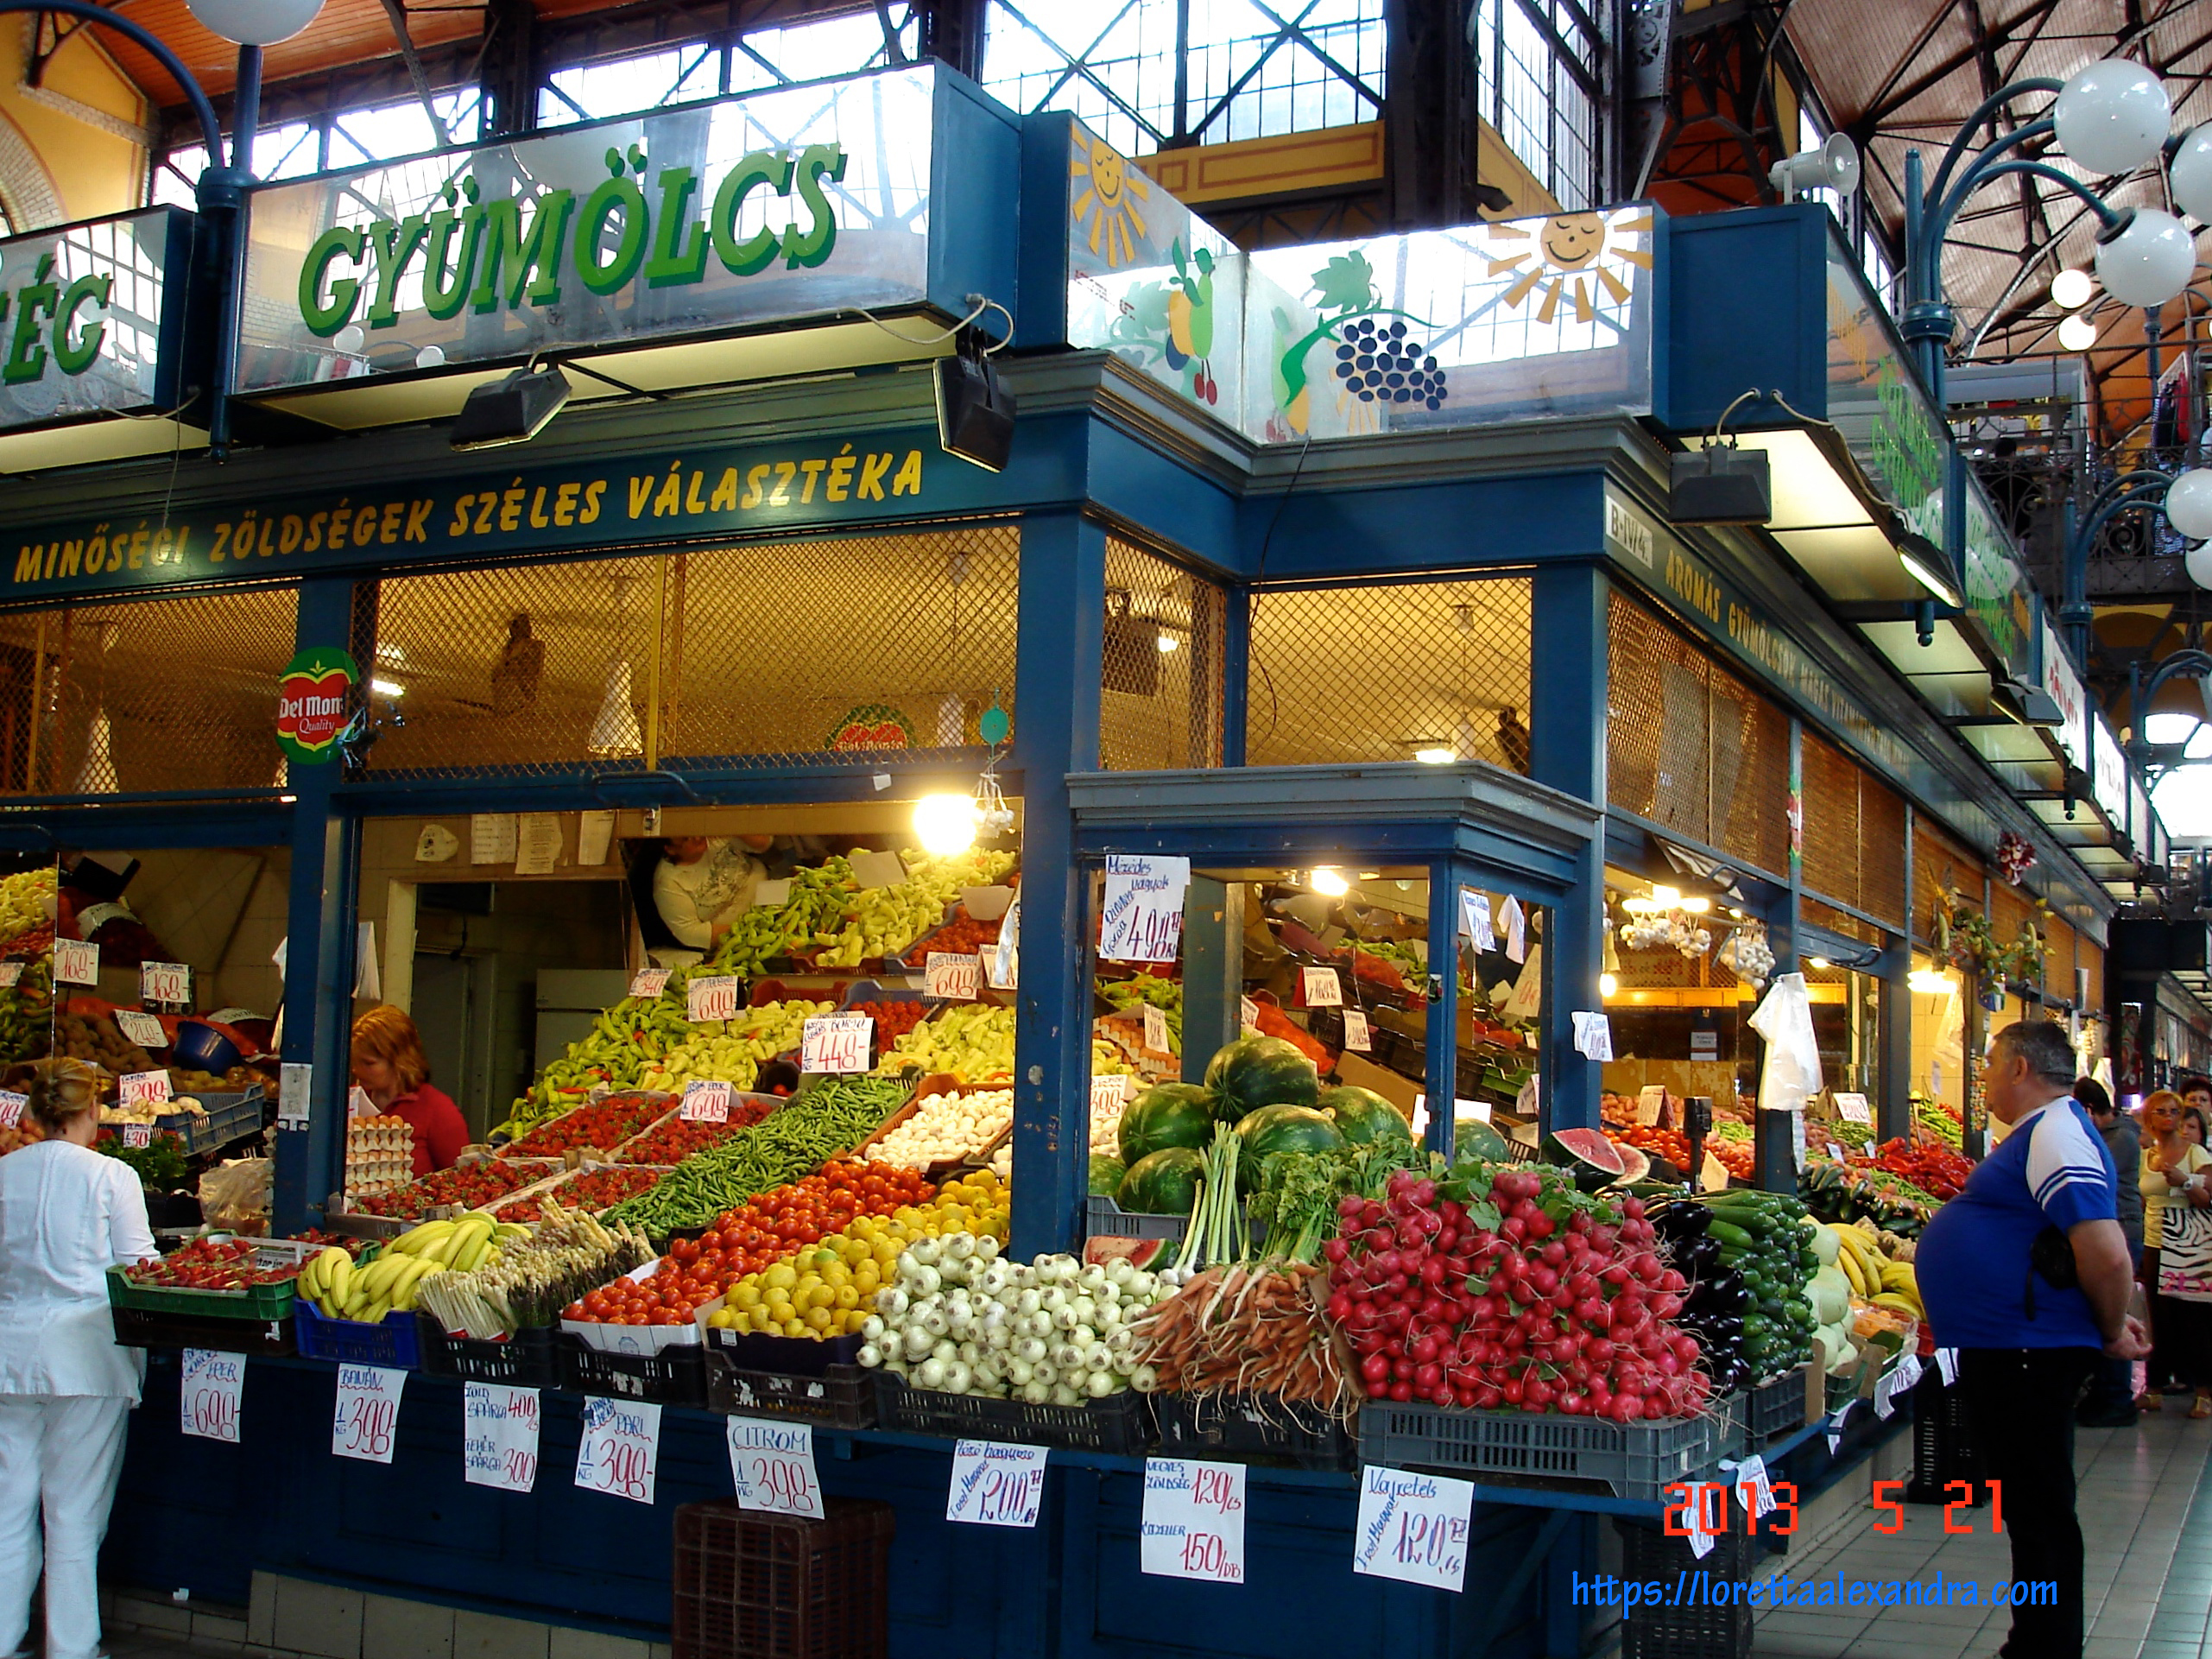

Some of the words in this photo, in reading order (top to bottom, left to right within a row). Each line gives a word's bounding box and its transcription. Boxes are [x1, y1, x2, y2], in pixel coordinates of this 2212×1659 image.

[299, 142, 847, 338] GYÜMÖLCS
[0, 252, 113, 386] ÉG
[14, 522, 192, 585] MINŐSÉGI
[211, 498, 433, 564] ZÖLDSÉGEK
[449, 478, 607, 537] SZÉLES
[628, 443, 923, 520] VÁLASZTÉKA
[1665, 549, 1721, 624] AROMÁS
[279, 697, 304, 719] Del
[299, 718, 335, 734] Quality
[61, 951, 95, 980] 168-
[154, 973, 190, 1000] 168-
[936, 967, 974, 997] 698
[818, 1033, 866, 1071] 448-
[340, 1368, 384, 1389] BANÁN
[195, 1389, 240, 1440] 698-
[346, 1397, 395, 1455] 398-
[732, 1426, 806, 1452] CITROM
[596, 1439, 653, 1499] 398-
[752, 1458, 816, 1511] 398-
[1146, 1472, 1190, 1490] ZÖLDSÉG
[1147, 1461, 1185, 1472] VEGYES
[979, 1469, 1028, 1521] 200
[1392, 1510, 1446, 1567] 120
